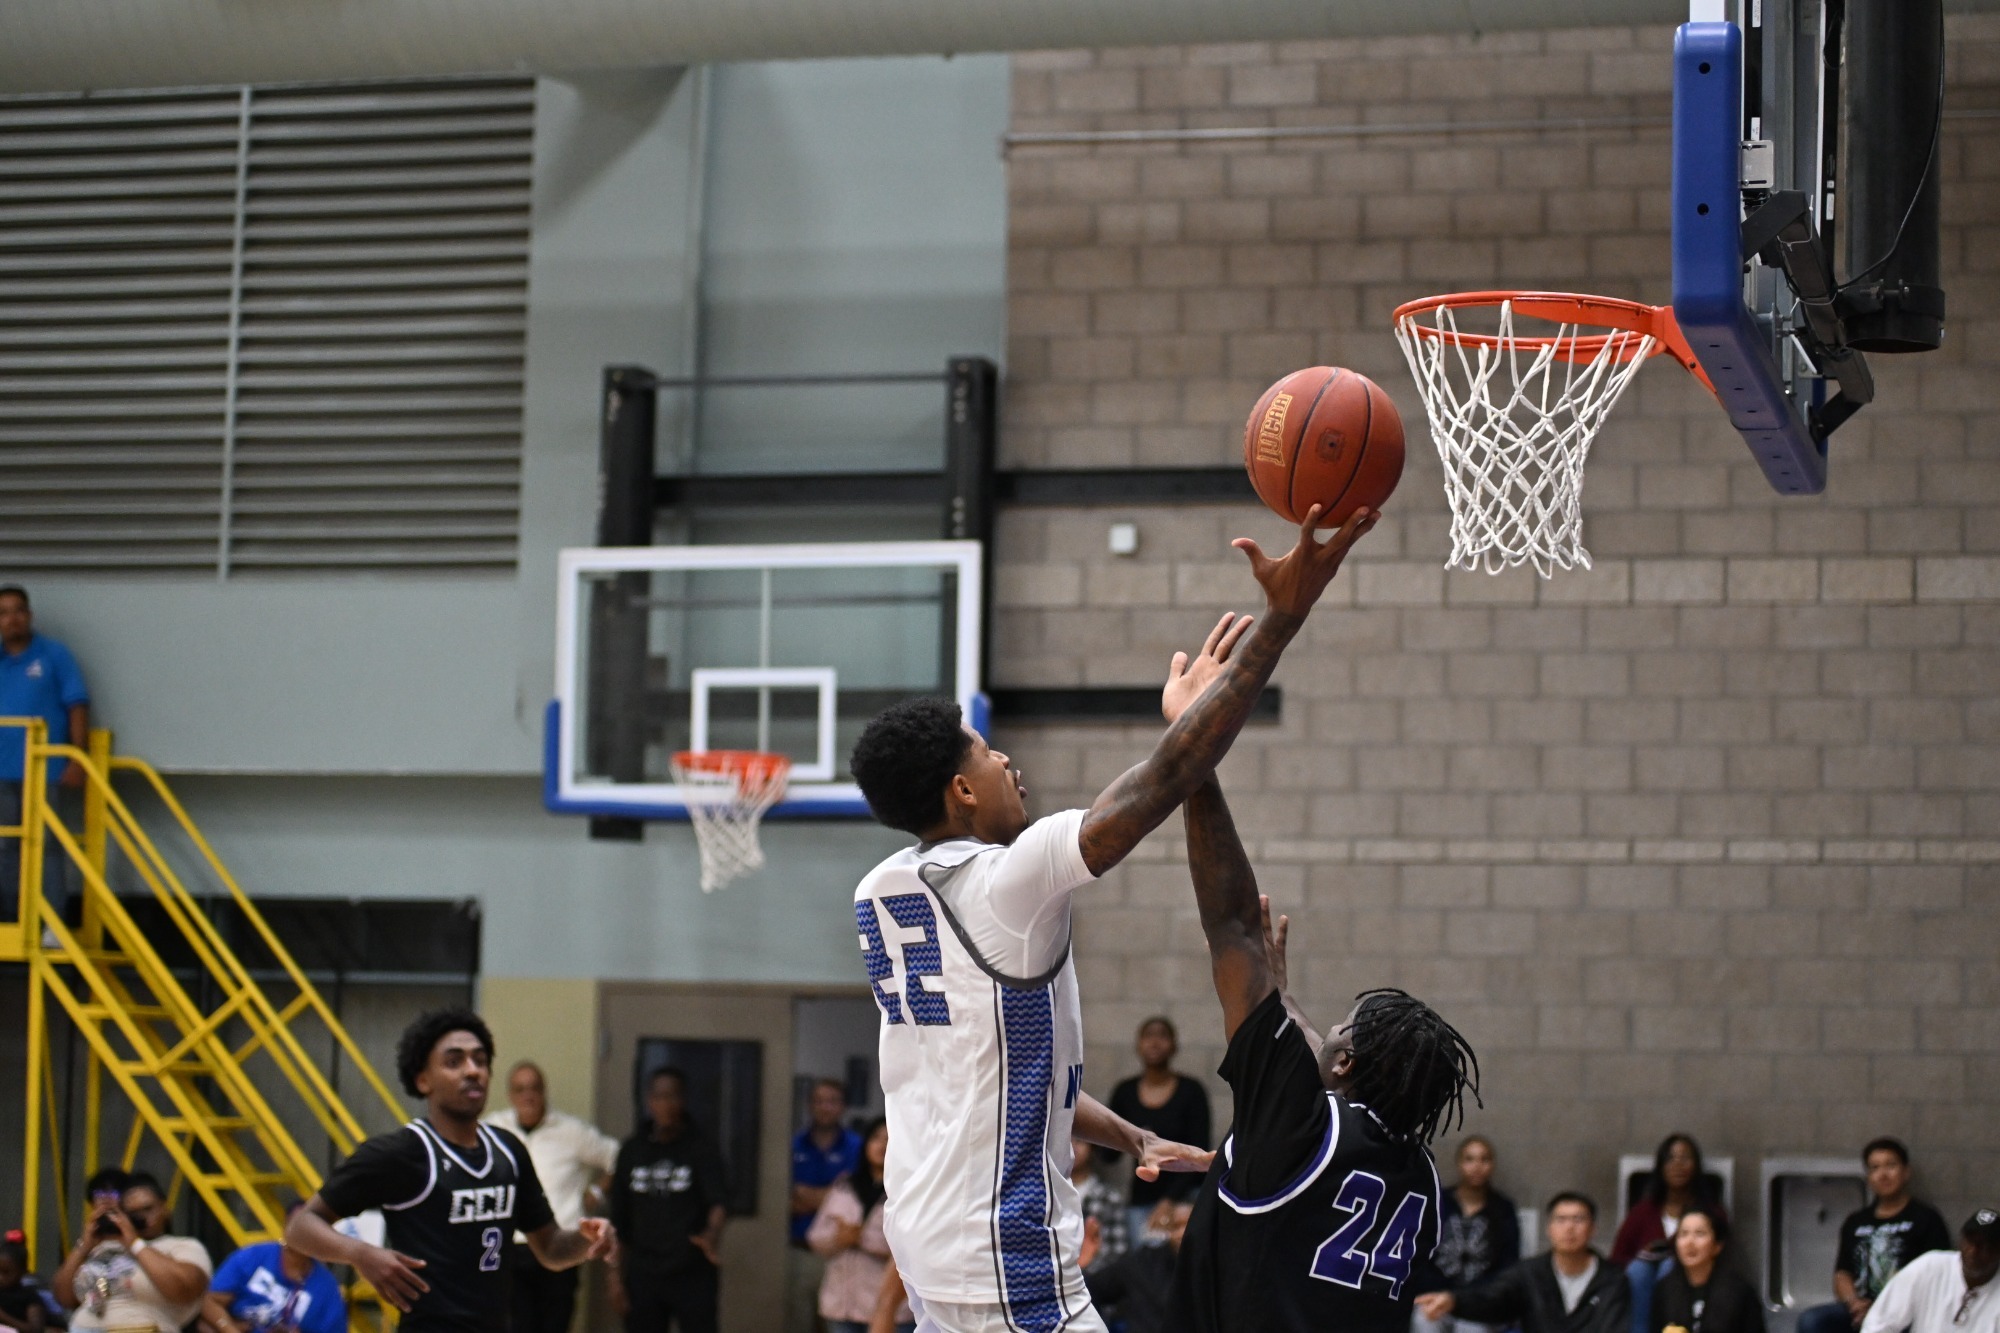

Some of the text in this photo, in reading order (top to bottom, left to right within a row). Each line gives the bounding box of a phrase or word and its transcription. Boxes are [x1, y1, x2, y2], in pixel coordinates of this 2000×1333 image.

[855, 892, 952, 1026] 22
[448, 1184, 517, 1225] GCU
[479, 1226, 503, 1272] 2
[1309, 1169, 1428, 1301] 24
